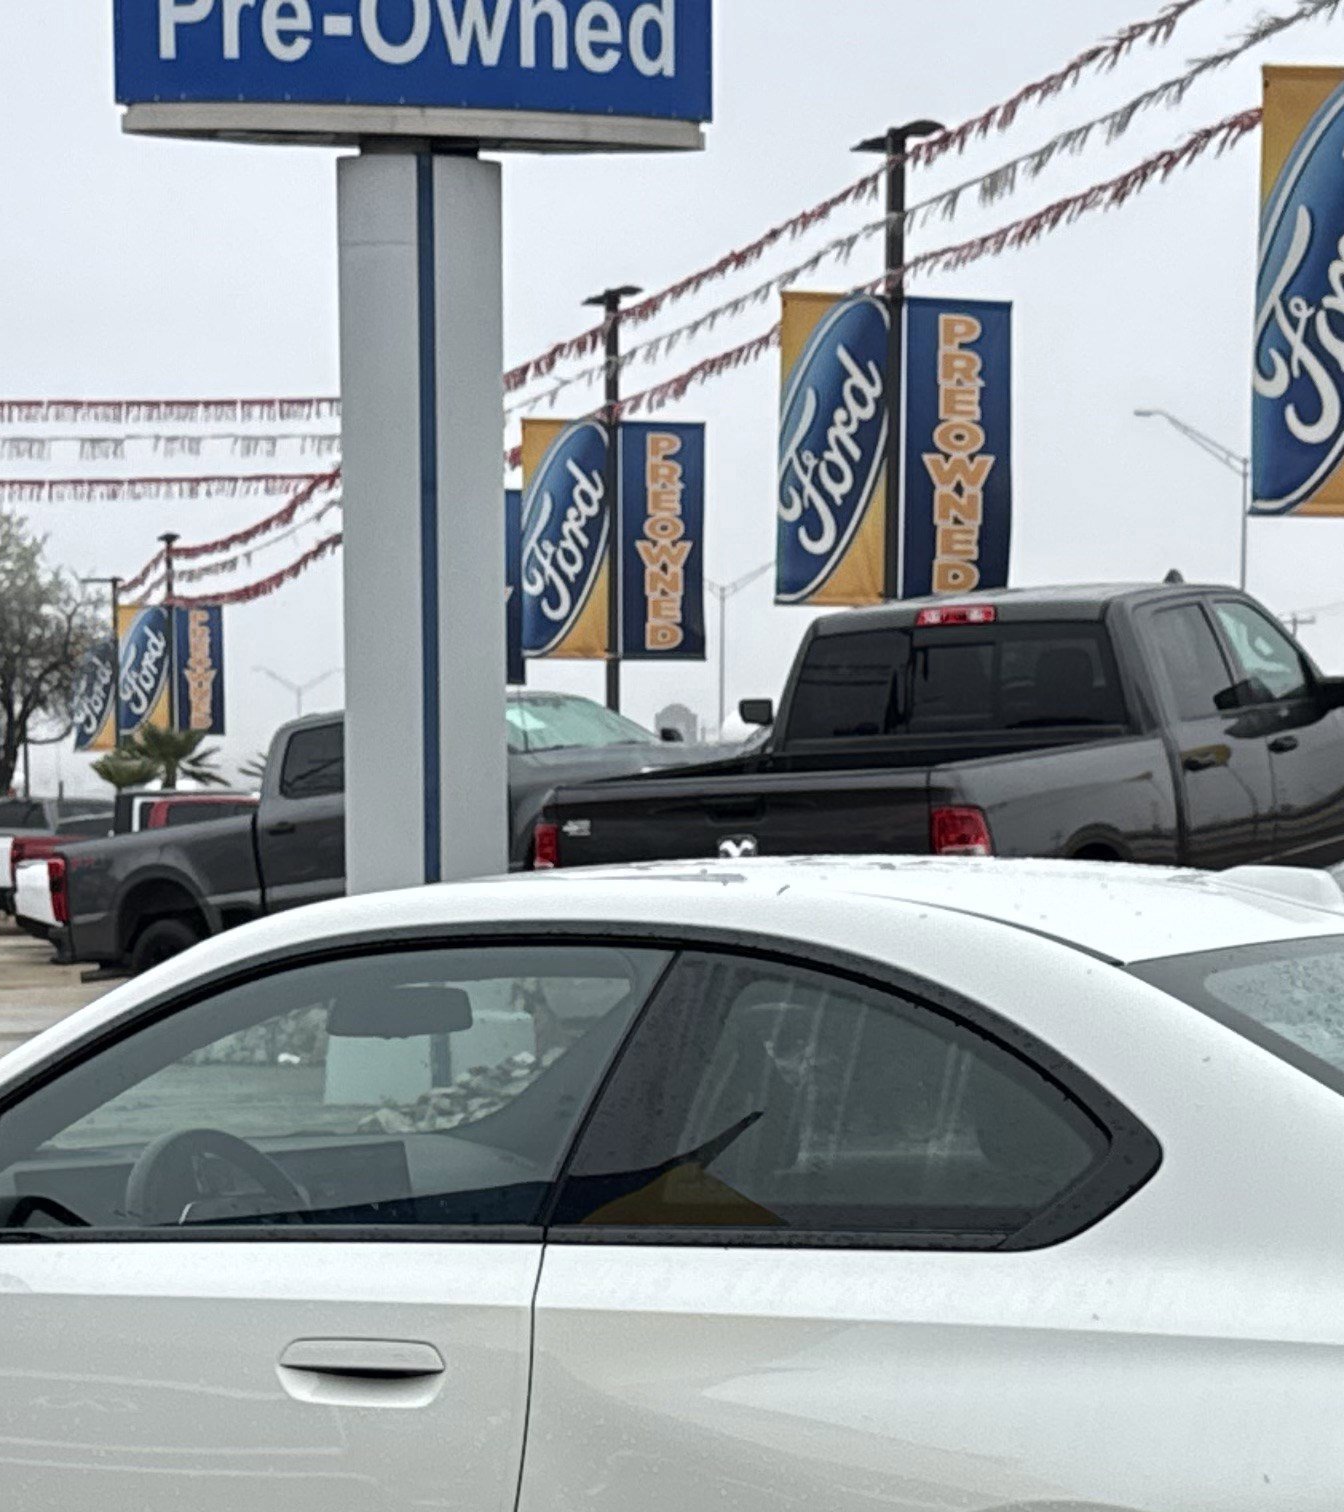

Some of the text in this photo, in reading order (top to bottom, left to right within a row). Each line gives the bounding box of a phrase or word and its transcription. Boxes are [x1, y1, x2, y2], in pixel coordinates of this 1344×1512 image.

[158, 0, 675, 77] Pre-Owned
[522, 460, 605, 621] Ford
[636, 433, 693, 651] PREOWNED
[776, 343, 883, 555] Ford
[922, 313, 995, 594] PREOWNED
[120, 625, 167, 715] Ford
